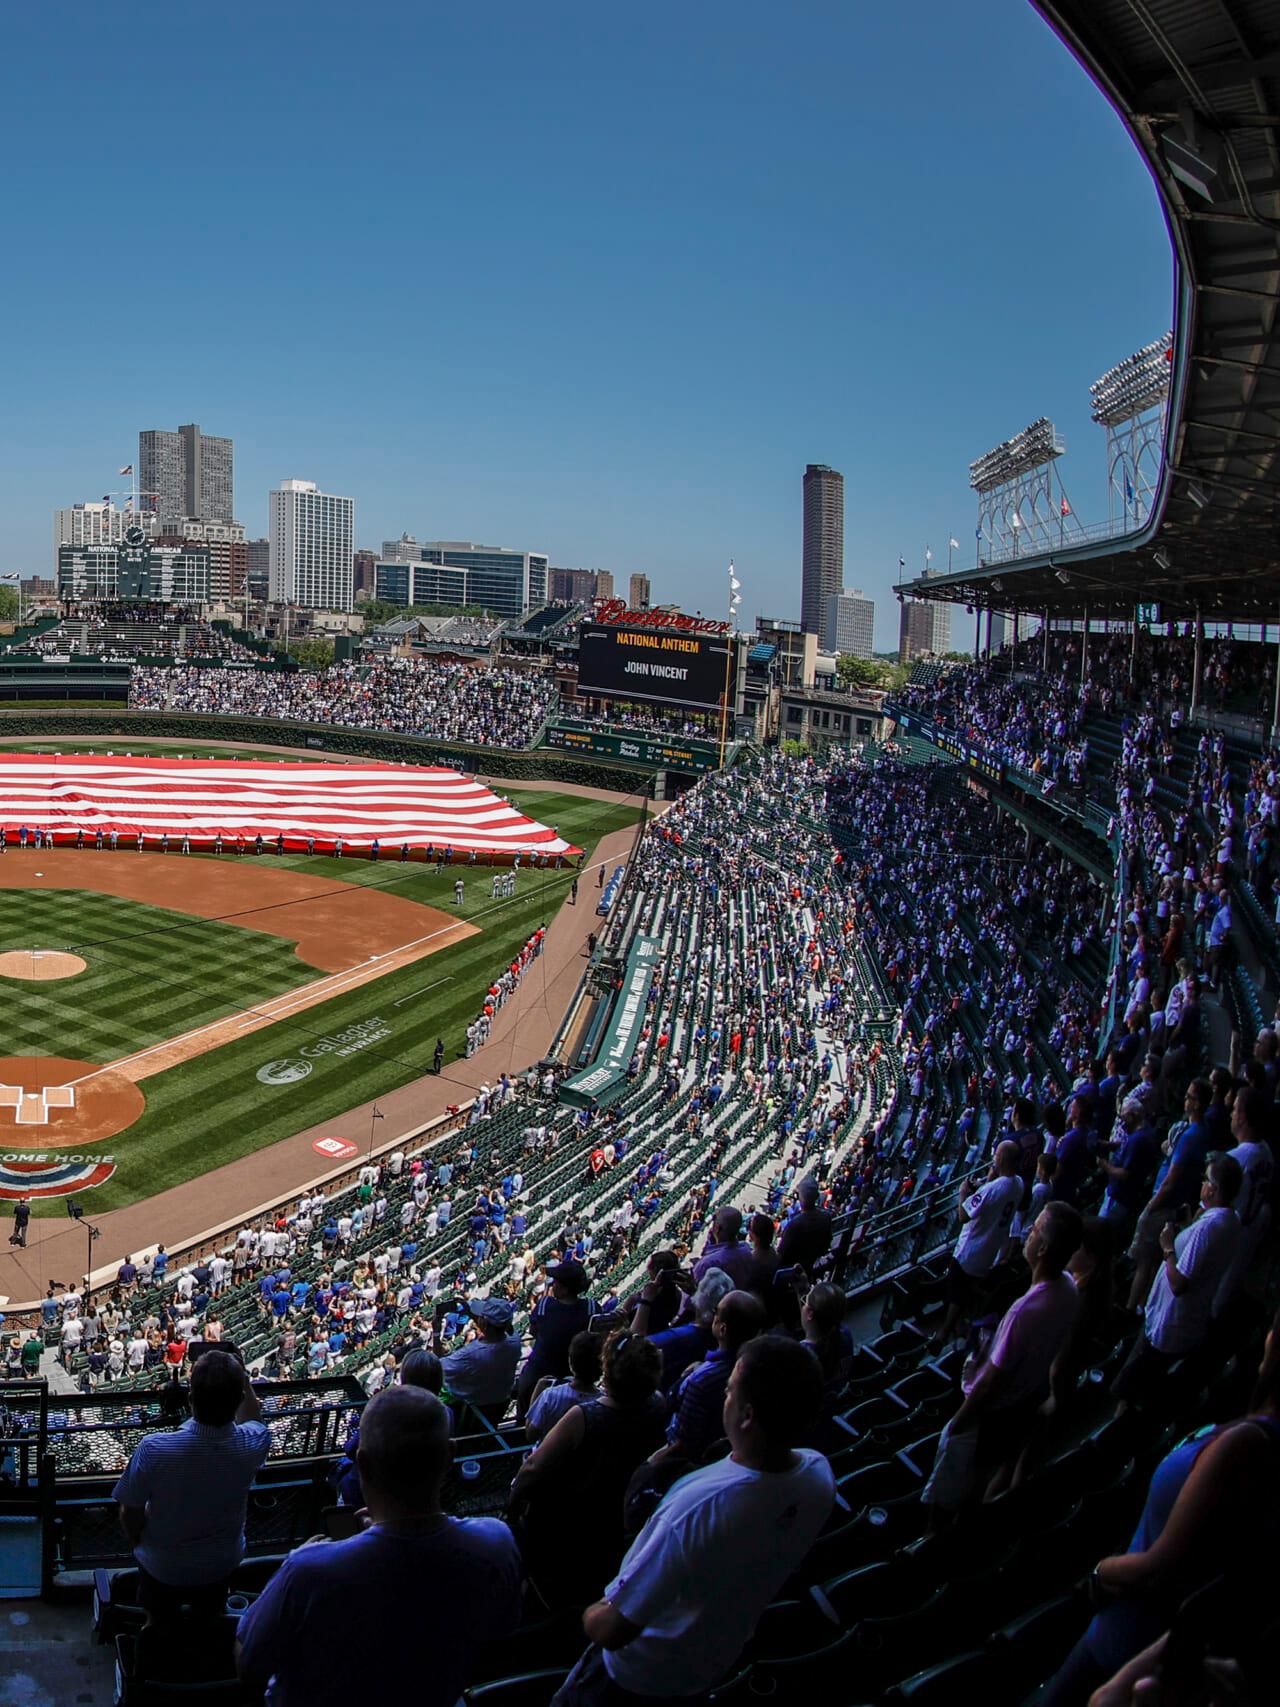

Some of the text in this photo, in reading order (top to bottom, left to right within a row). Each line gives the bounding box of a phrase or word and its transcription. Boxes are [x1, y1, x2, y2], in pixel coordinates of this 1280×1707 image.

[592, 598, 732, 633] Budweiser
[616, 632, 699, 653] NATIONAL ANTHEM
[624, 661, 688, 680] JOHN VINCENT
[300, 1016, 388, 1057] Gallagher
[335, 1028, 392, 1057] INSURANCE
[54, 1154, 114, 1163] HOME
